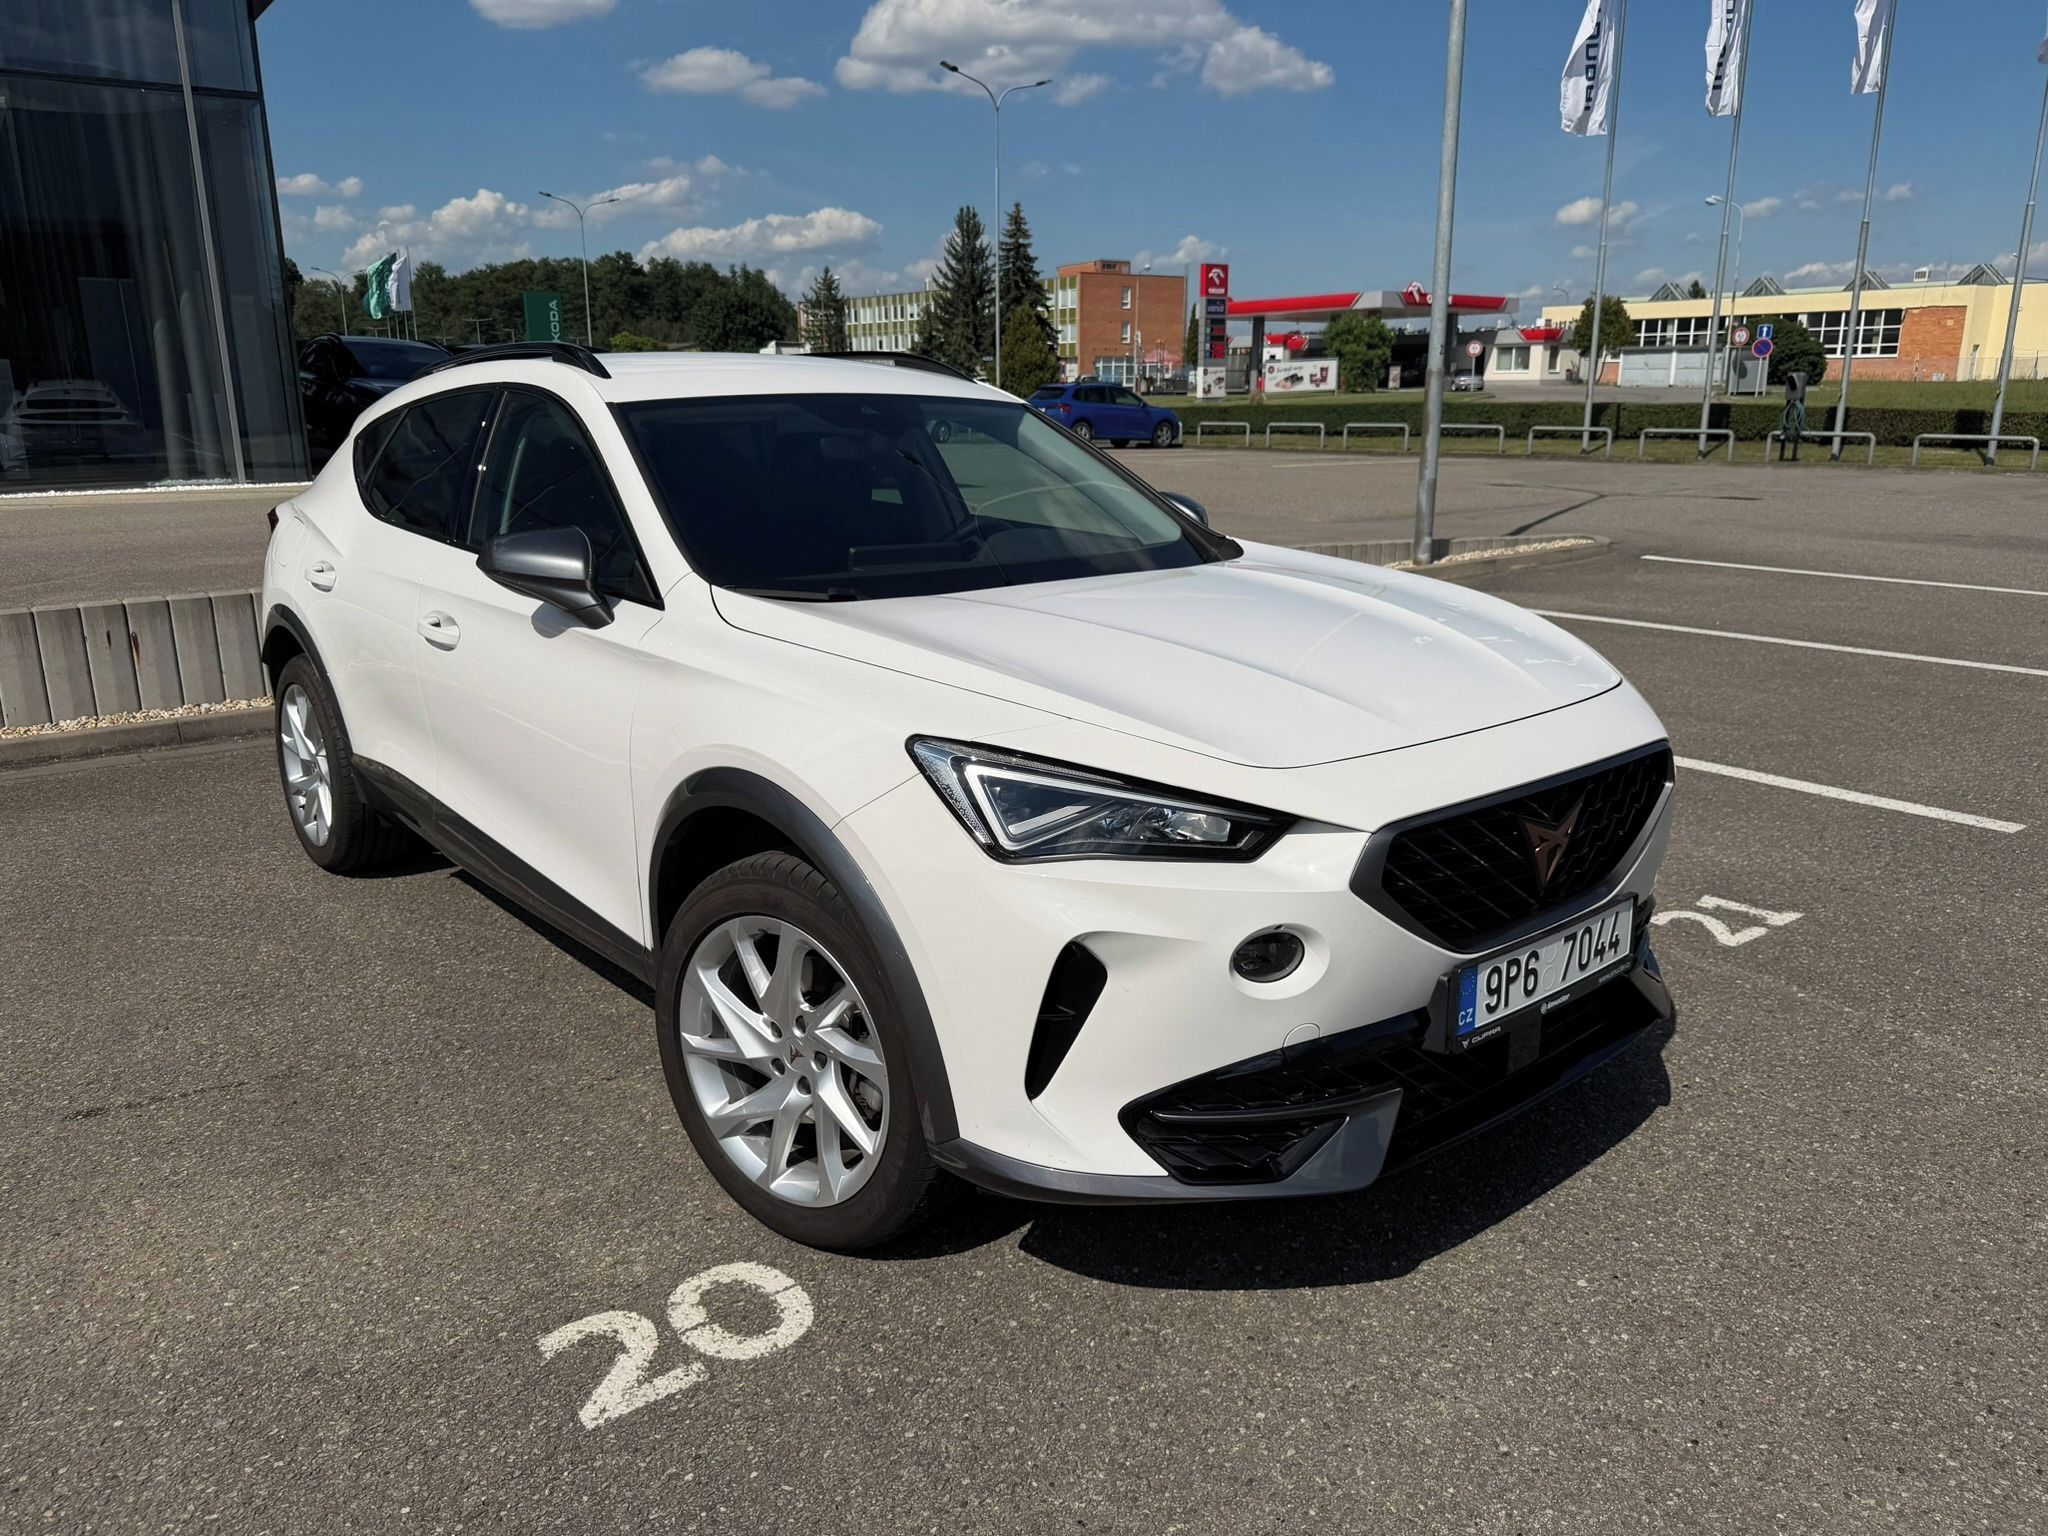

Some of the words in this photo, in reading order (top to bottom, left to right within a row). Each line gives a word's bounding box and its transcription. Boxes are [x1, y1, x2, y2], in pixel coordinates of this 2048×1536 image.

[549, 299, 561, 343] KODA
[1650, 895, 1804, 946] 21
[1484, 950, 1540, 1014] 9P6
[1559, 911, 1620, 982] 7044
[1458, 1008, 1473, 1026] CZ
[1471, 1026, 1502, 1044] CUPRA
[536, 1261, 814, 1430] 20
